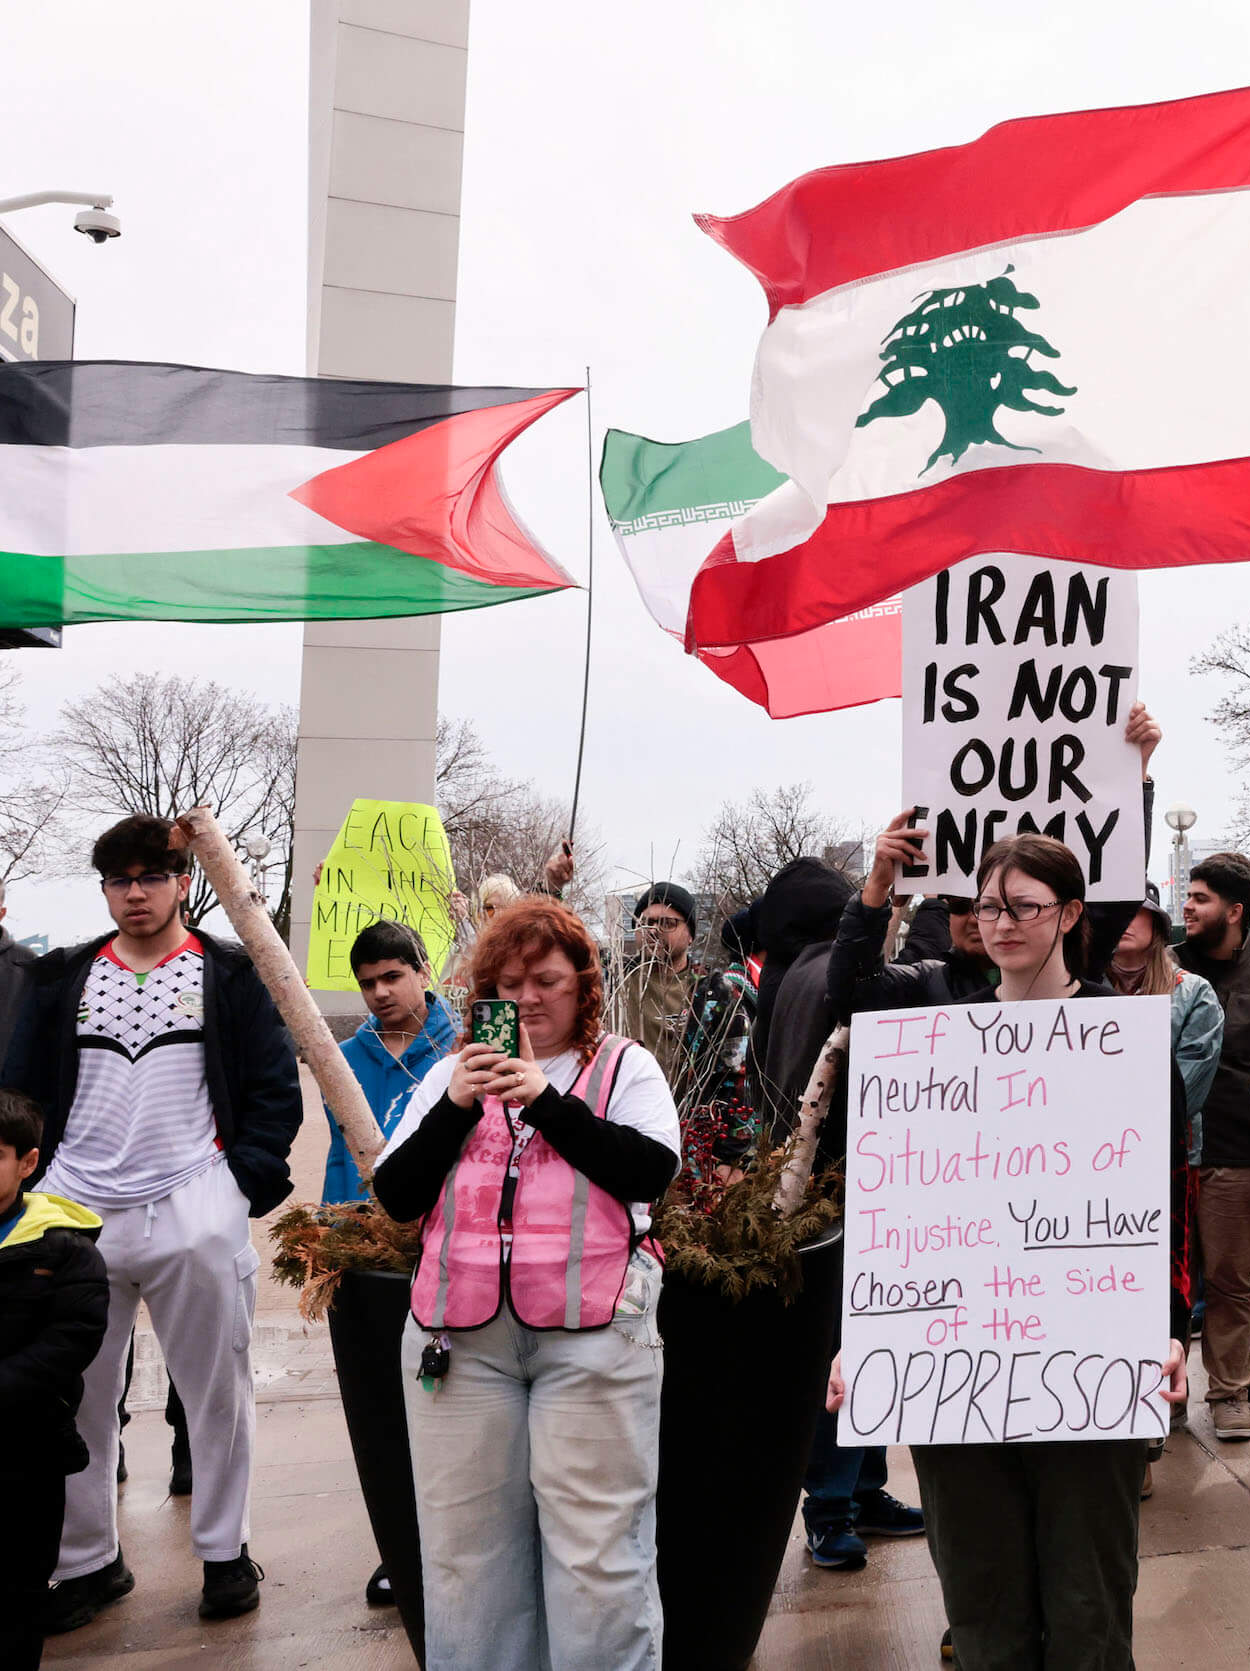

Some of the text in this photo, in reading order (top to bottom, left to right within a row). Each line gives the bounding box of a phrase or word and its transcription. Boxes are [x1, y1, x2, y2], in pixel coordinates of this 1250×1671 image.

[935, 565, 1110, 647] IRAN
[923, 658, 1133, 726] IS NOT
[950, 734, 1093, 804] OUR
[326, 868, 440, 894] IN THE
[875, 1005, 1124, 1059] If You Are
[996, 1069, 1048, 1112] In
[856, 1128, 1142, 1192] Situations of
[1008, 1199, 1069, 1244] You
[1086, 1198, 1162, 1240] Have
[983, 1265, 1046, 1299] the
[926, 1306, 1047, 1346] of the
[850, 1349, 1167, 1443] OPPRESSOR
